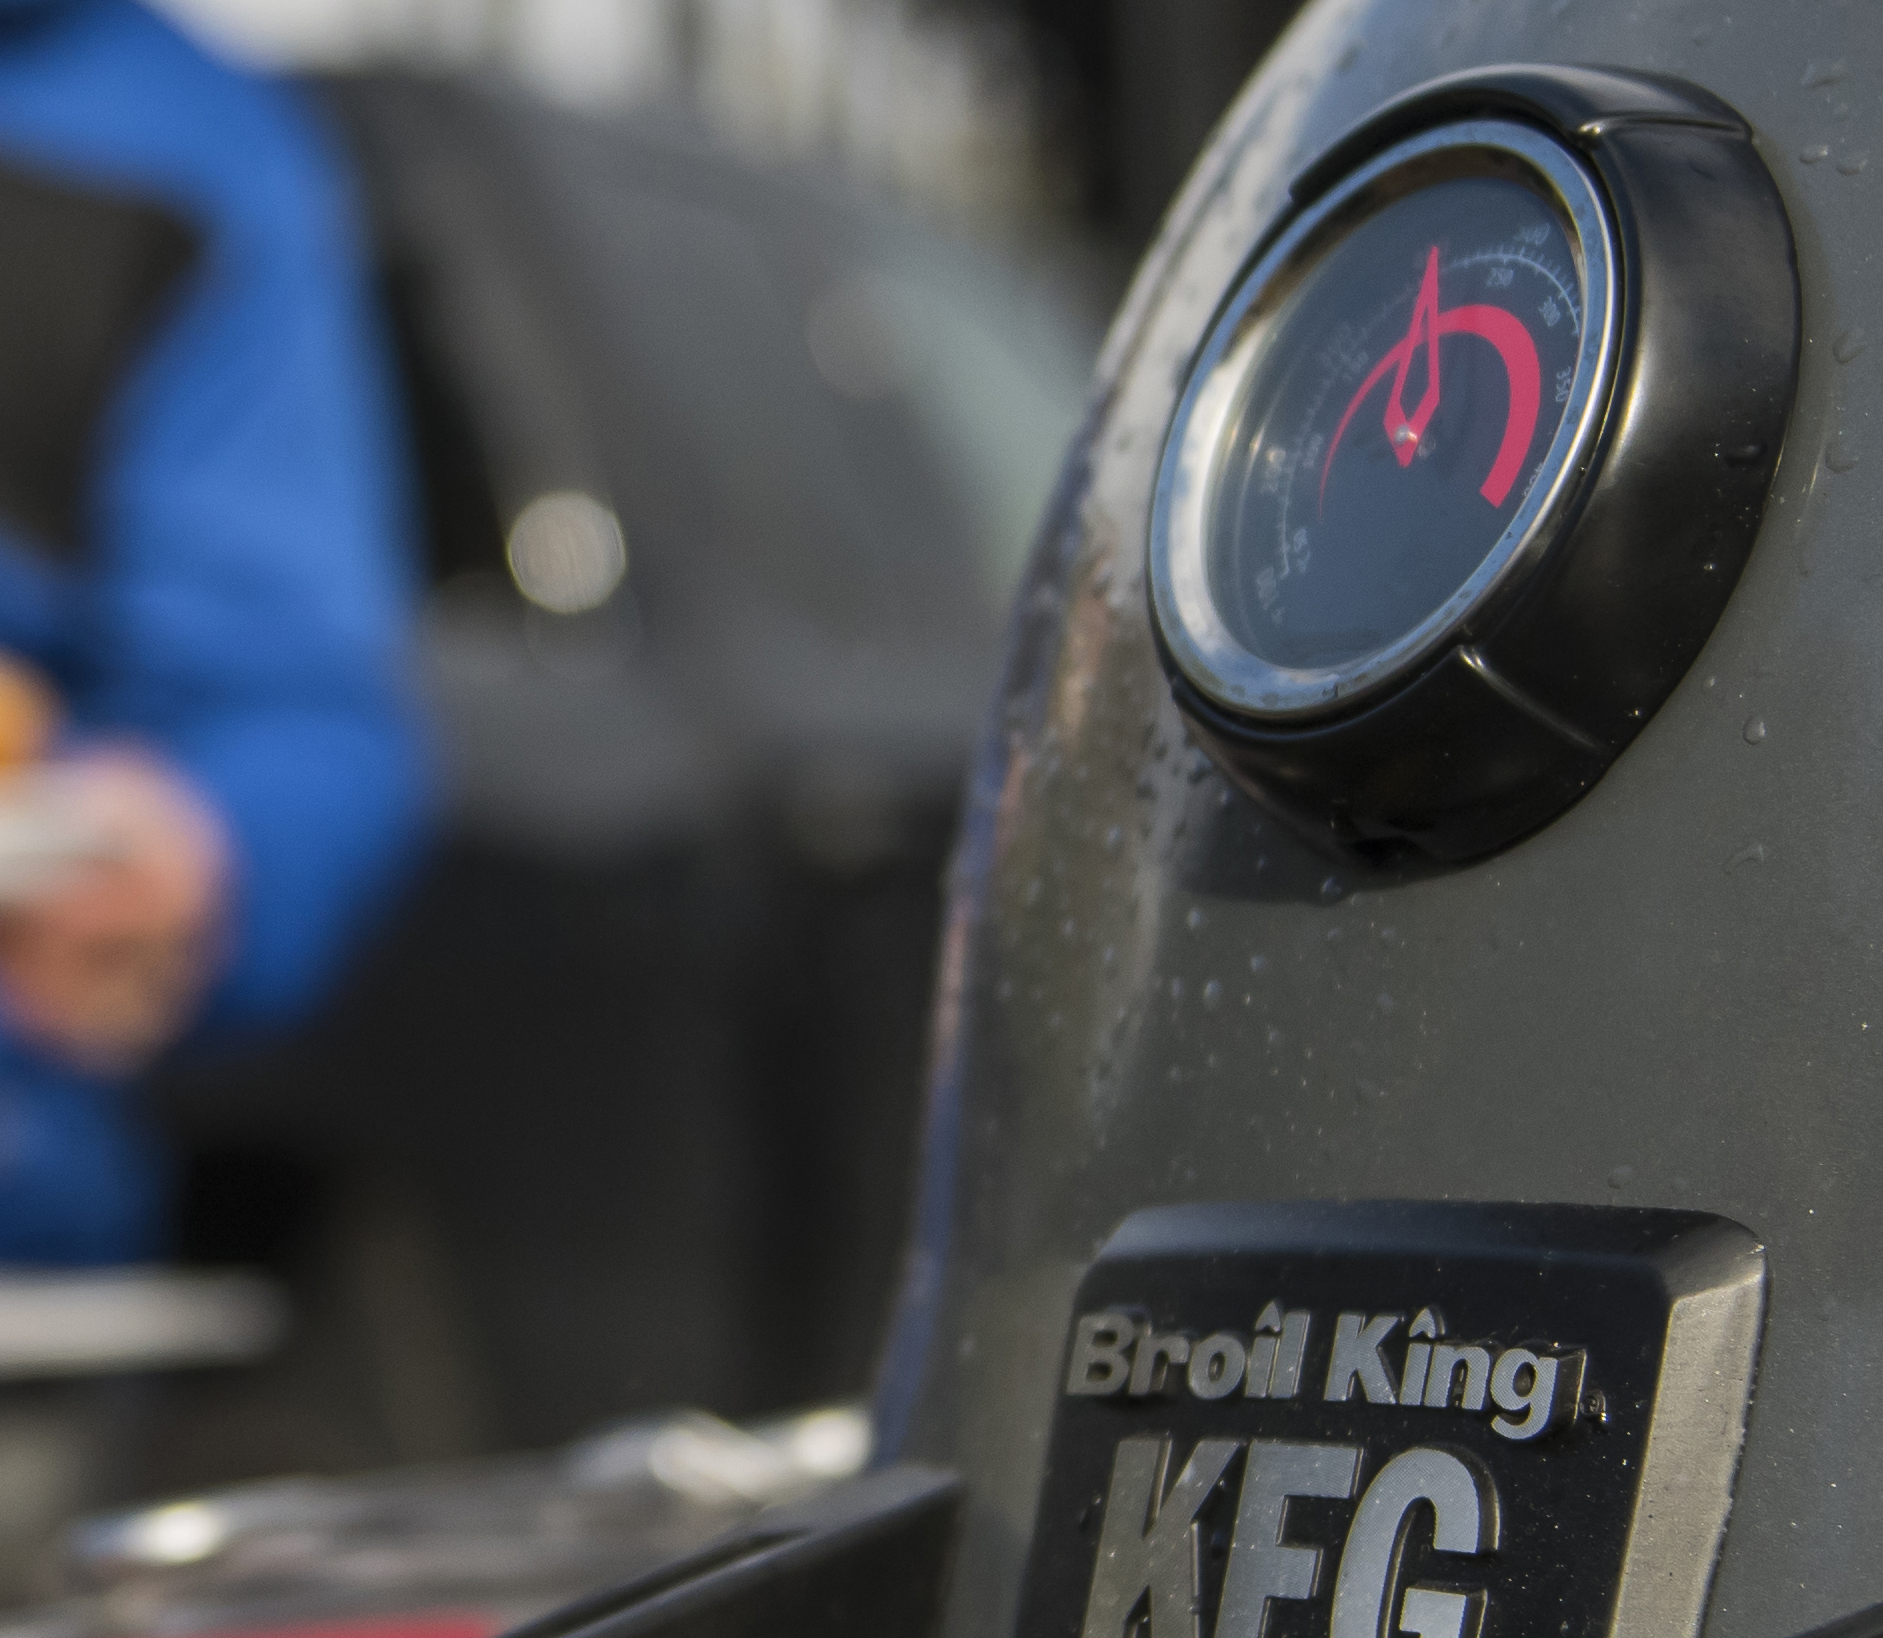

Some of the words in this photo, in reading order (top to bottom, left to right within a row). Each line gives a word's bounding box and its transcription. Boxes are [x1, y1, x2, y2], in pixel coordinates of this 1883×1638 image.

[1555, 365, 1572, 404] 350
[1065, 1301, 1310, 1399] Broil
[1323, 1307, 1585, 1441] King
